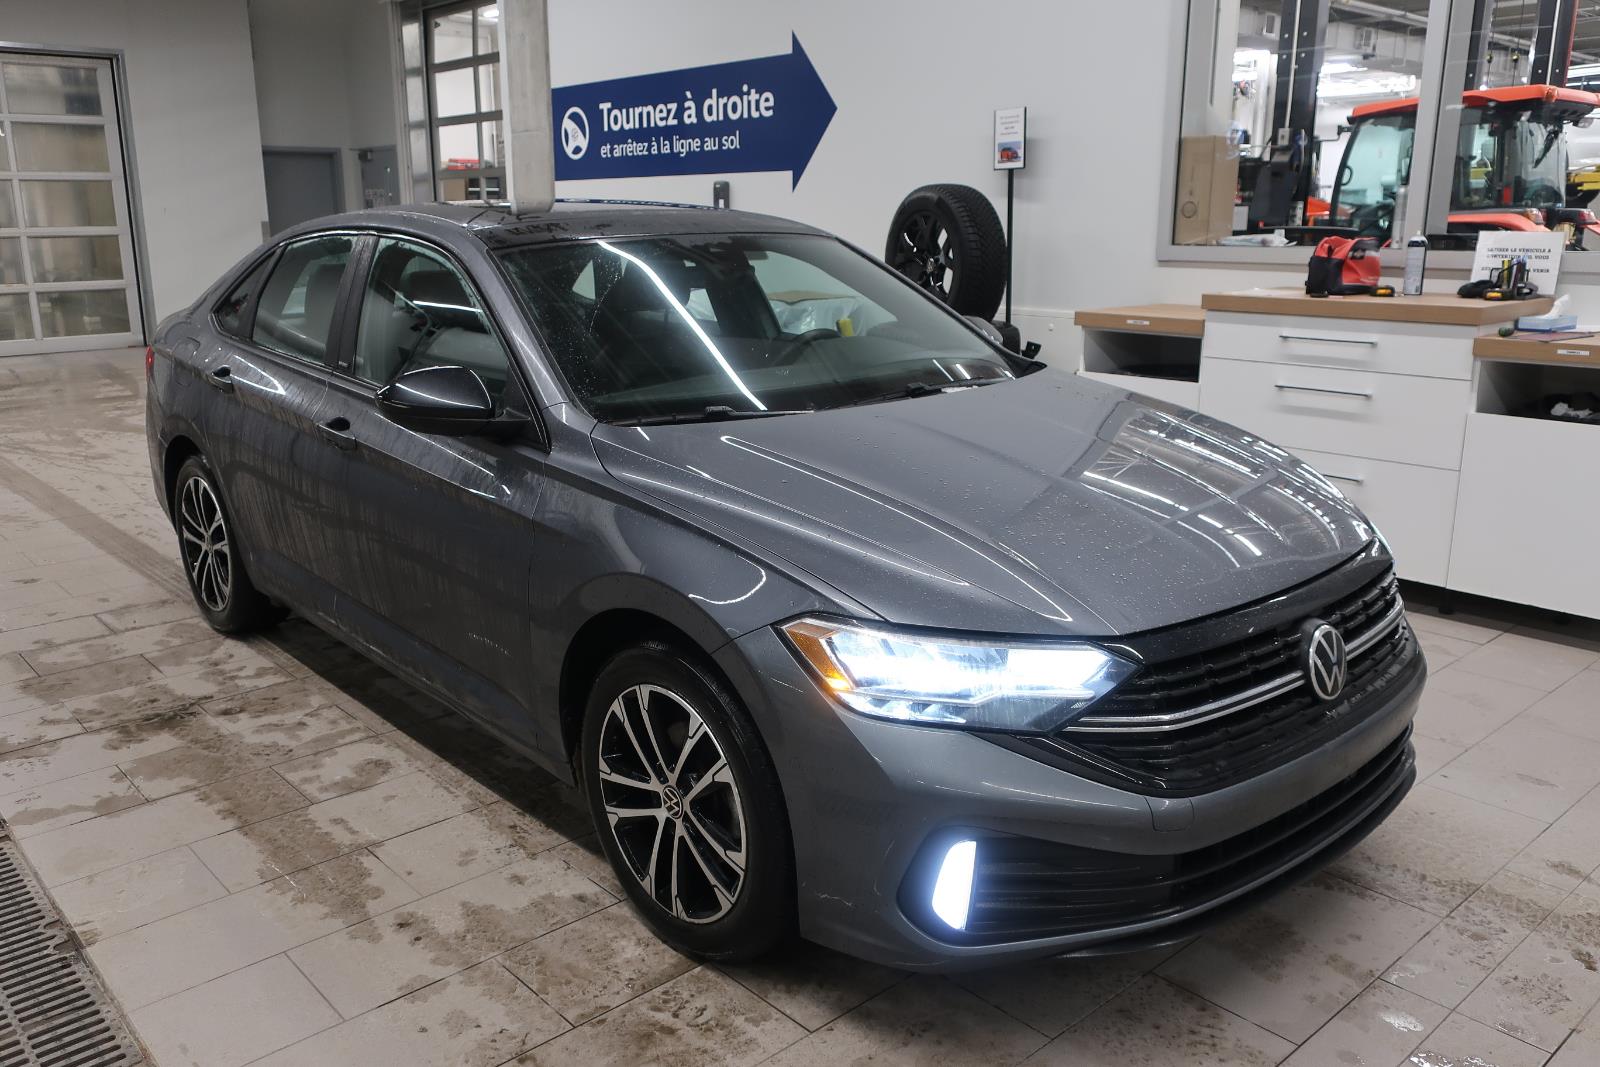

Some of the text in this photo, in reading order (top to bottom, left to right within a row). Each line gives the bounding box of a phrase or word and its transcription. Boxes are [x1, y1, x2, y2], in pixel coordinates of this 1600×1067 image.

[599, 84, 775, 132] Tournez à droite
[600, 130, 741, 158] et arrêtez à la ligne au sol
